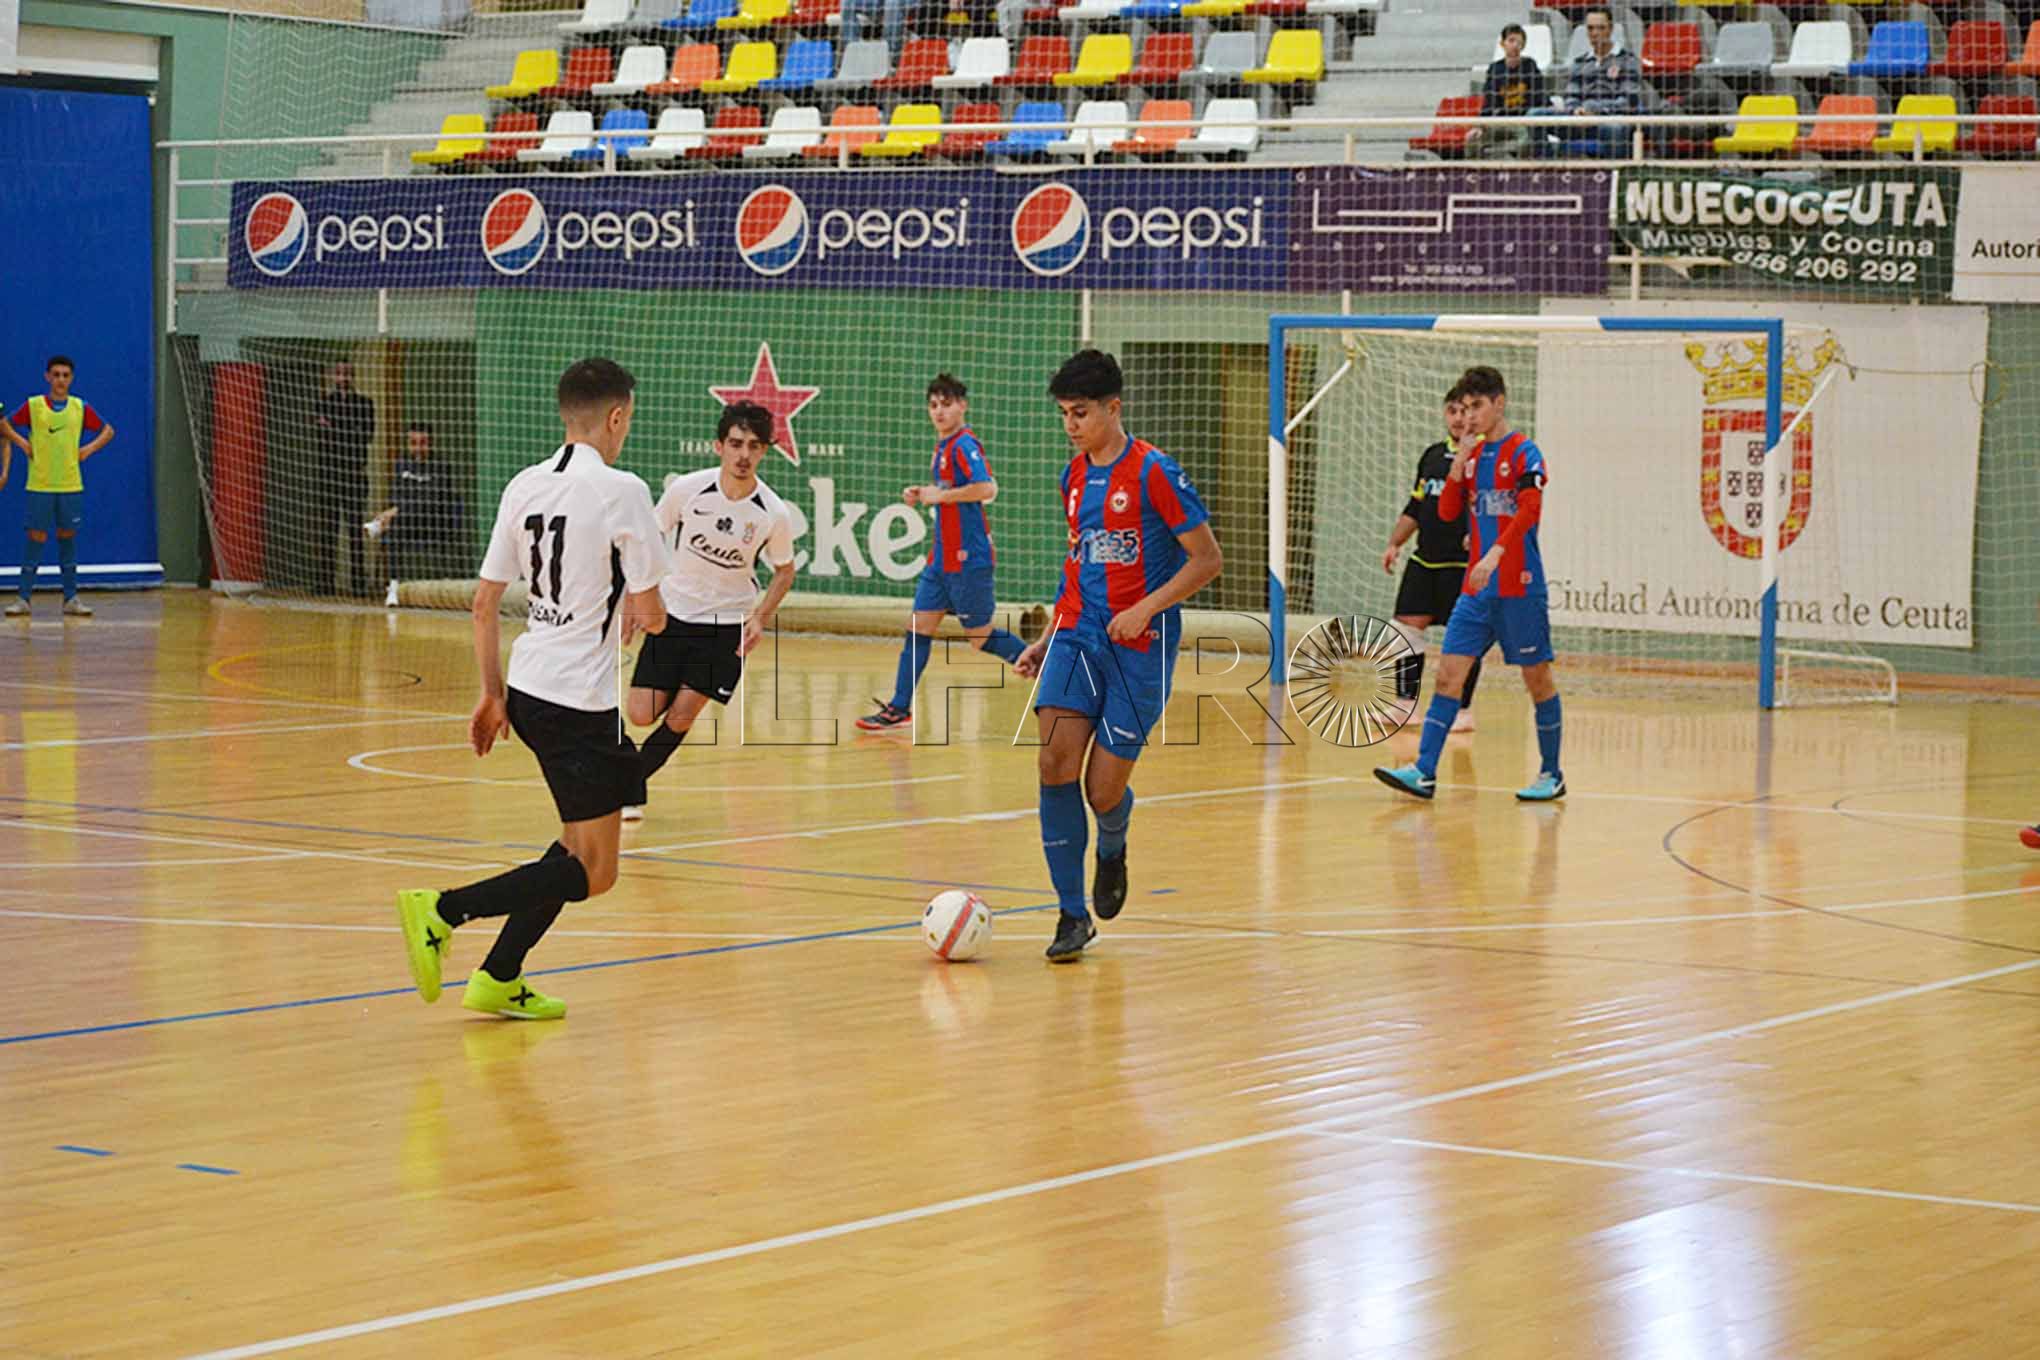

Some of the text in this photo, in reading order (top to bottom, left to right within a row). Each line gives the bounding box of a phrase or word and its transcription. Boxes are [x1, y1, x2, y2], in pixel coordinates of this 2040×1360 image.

[316, 204, 444, 261] pepsi
[556, 199, 695, 260] pepsi
[818, 196, 969, 260] pepsi
[1101, 195, 1263, 259] pepsi
[1625, 180, 1948, 228] MUECOCEUTA
[1641, 229, 1935, 257] Muebles y Cocina
[1794, 257, 1849, 281] 206
[1860, 259, 1918, 283] 292
[523, 512, 568, 605] 11
[1547, 580, 1648, 615] Ciudad
[1832, 592, 1871, 626] de
[1880, 597, 1969, 630] Ceuta
